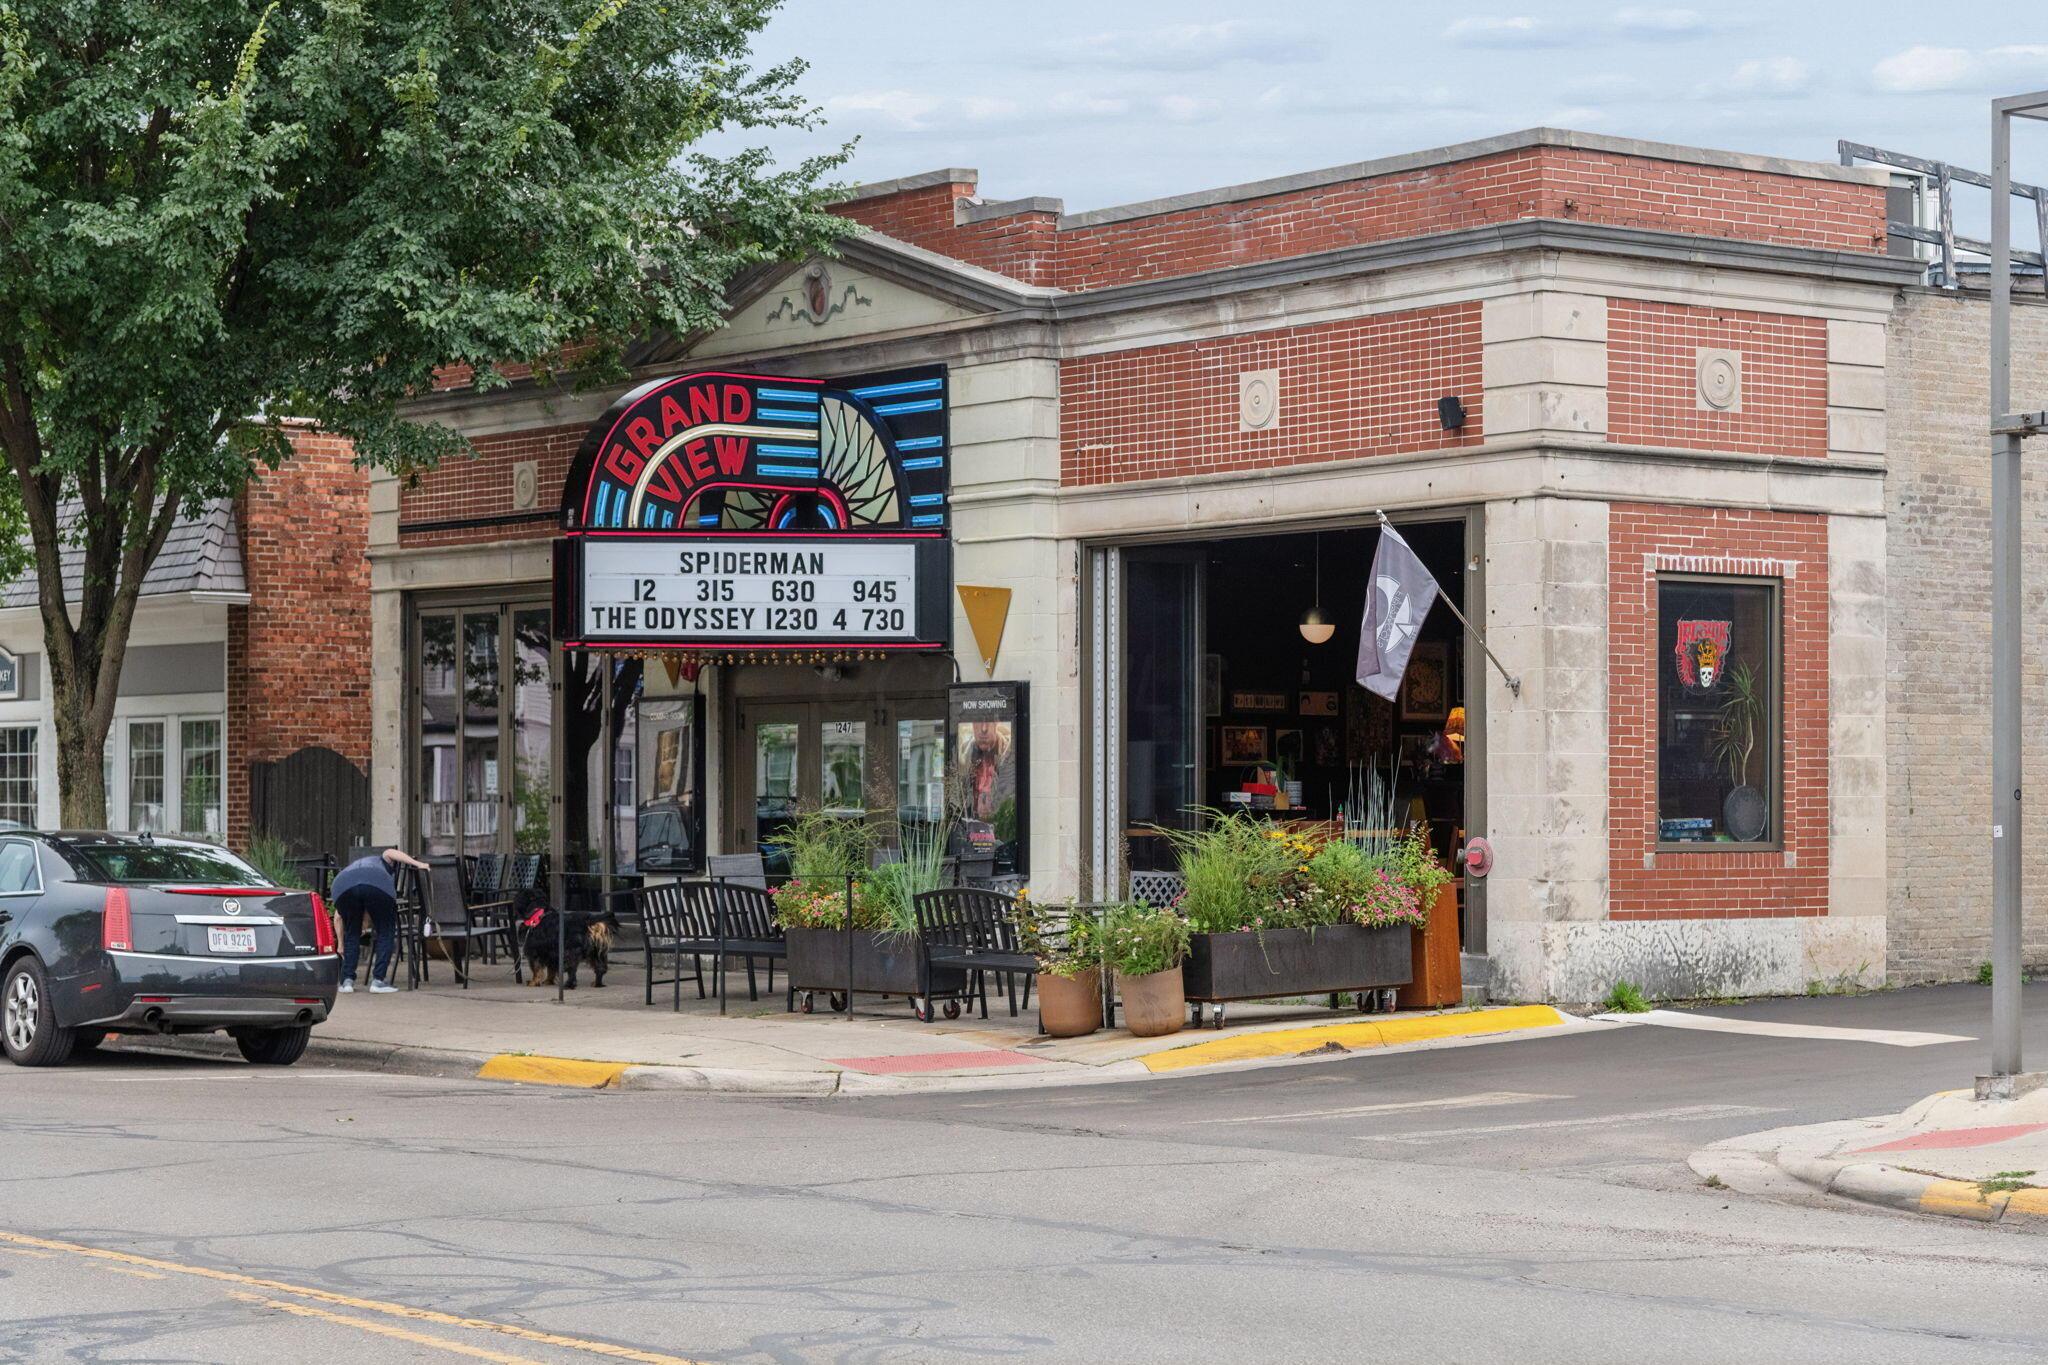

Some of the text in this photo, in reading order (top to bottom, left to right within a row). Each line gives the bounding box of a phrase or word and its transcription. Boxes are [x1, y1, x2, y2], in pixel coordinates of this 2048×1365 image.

[604, 383, 751, 486] GRAND
[647, 436, 749, 504] VIEW
[679, 551, 824, 575] SPIDERMAN
[634, 579, 897, 603] 12 315 630 945
[591, 606, 905, 631] THE ODYSSEY 1230 4 730
[963, 699, 1007, 710] NOW SHOWING
[835, 722, 852, 733] 1247
[230, 933, 252, 947] 9226
